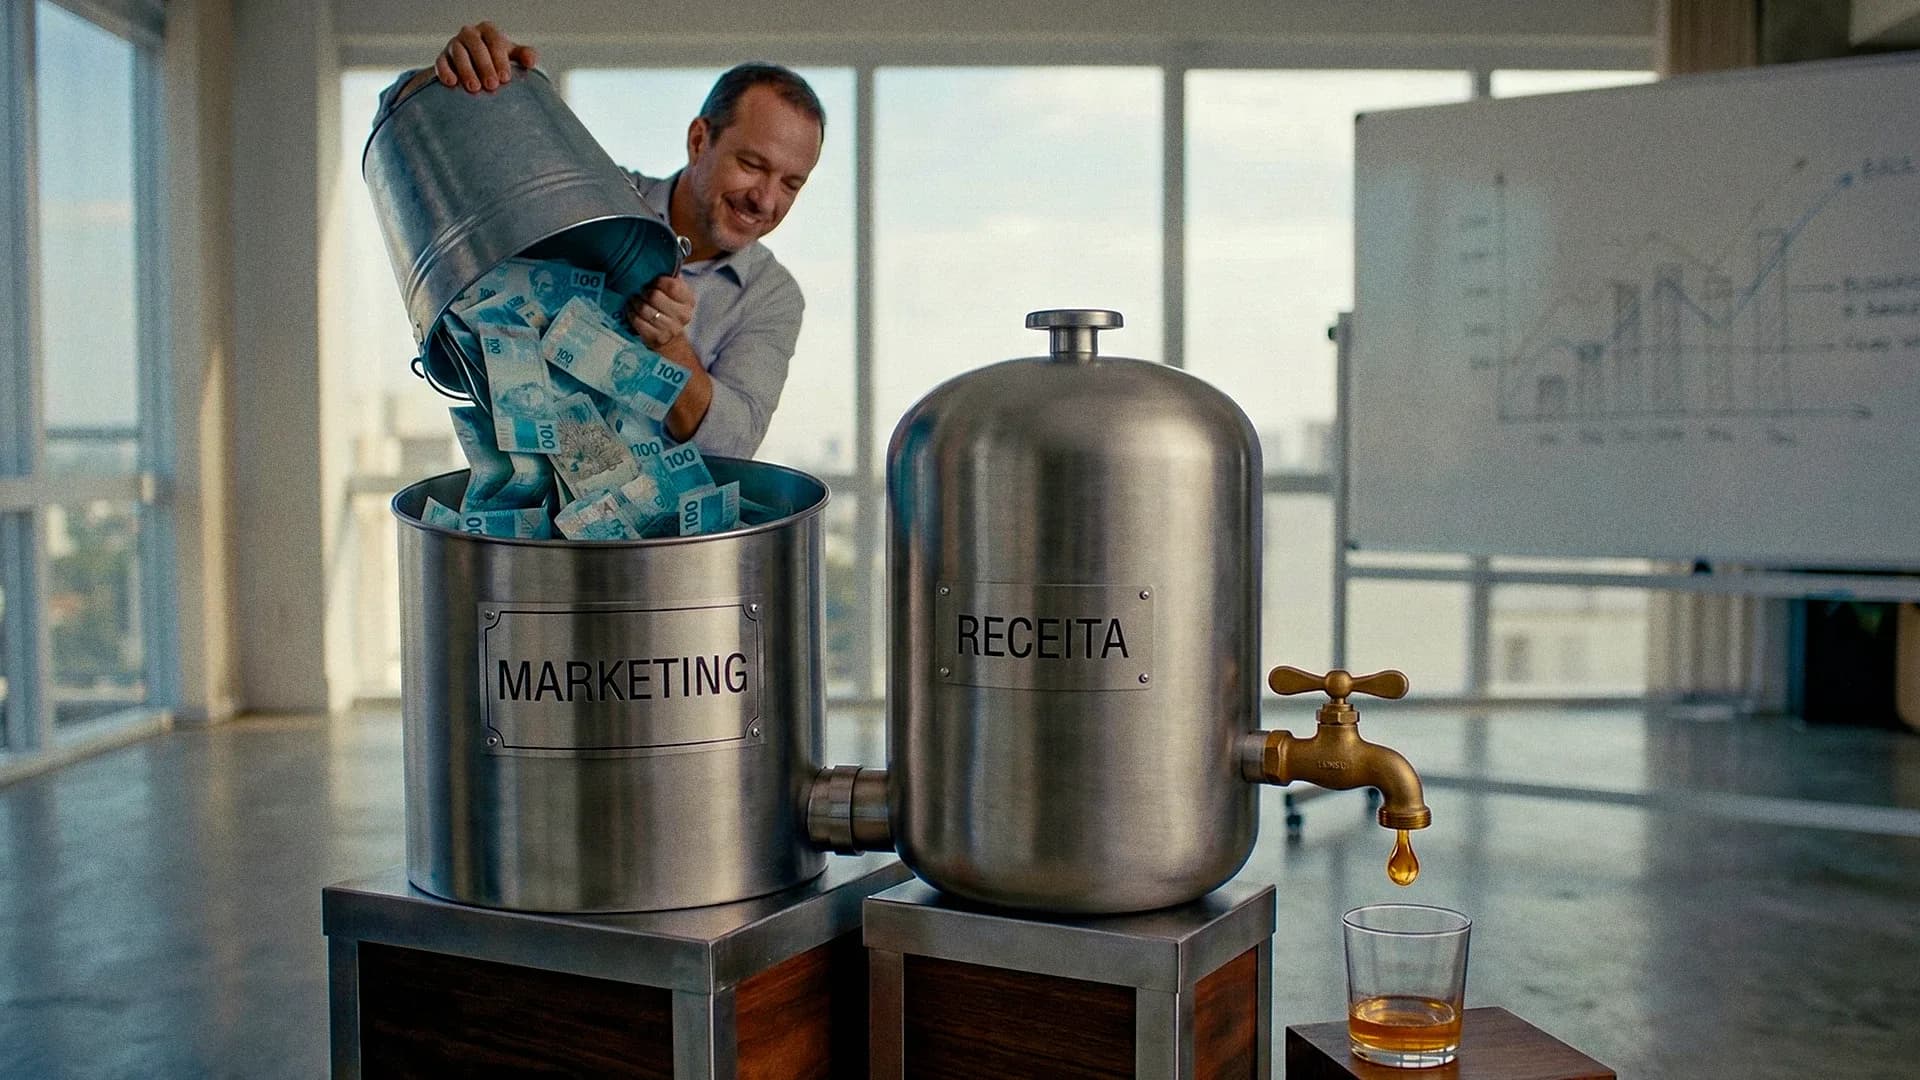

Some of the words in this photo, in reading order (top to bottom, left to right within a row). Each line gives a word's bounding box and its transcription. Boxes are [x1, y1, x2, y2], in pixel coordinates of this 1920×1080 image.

[574, 272, 600, 288] 100
[488, 338, 501, 354] 100
[556, 348, 574, 364] 100
[657, 363, 685, 385] 100
[538, 423, 556, 450] 100
[664, 448, 696, 469] 100
[684, 500, 698, 530] 100
[958, 614, 1129, 659] RECEITA
[499, 652, 748, 702] MARKETING
